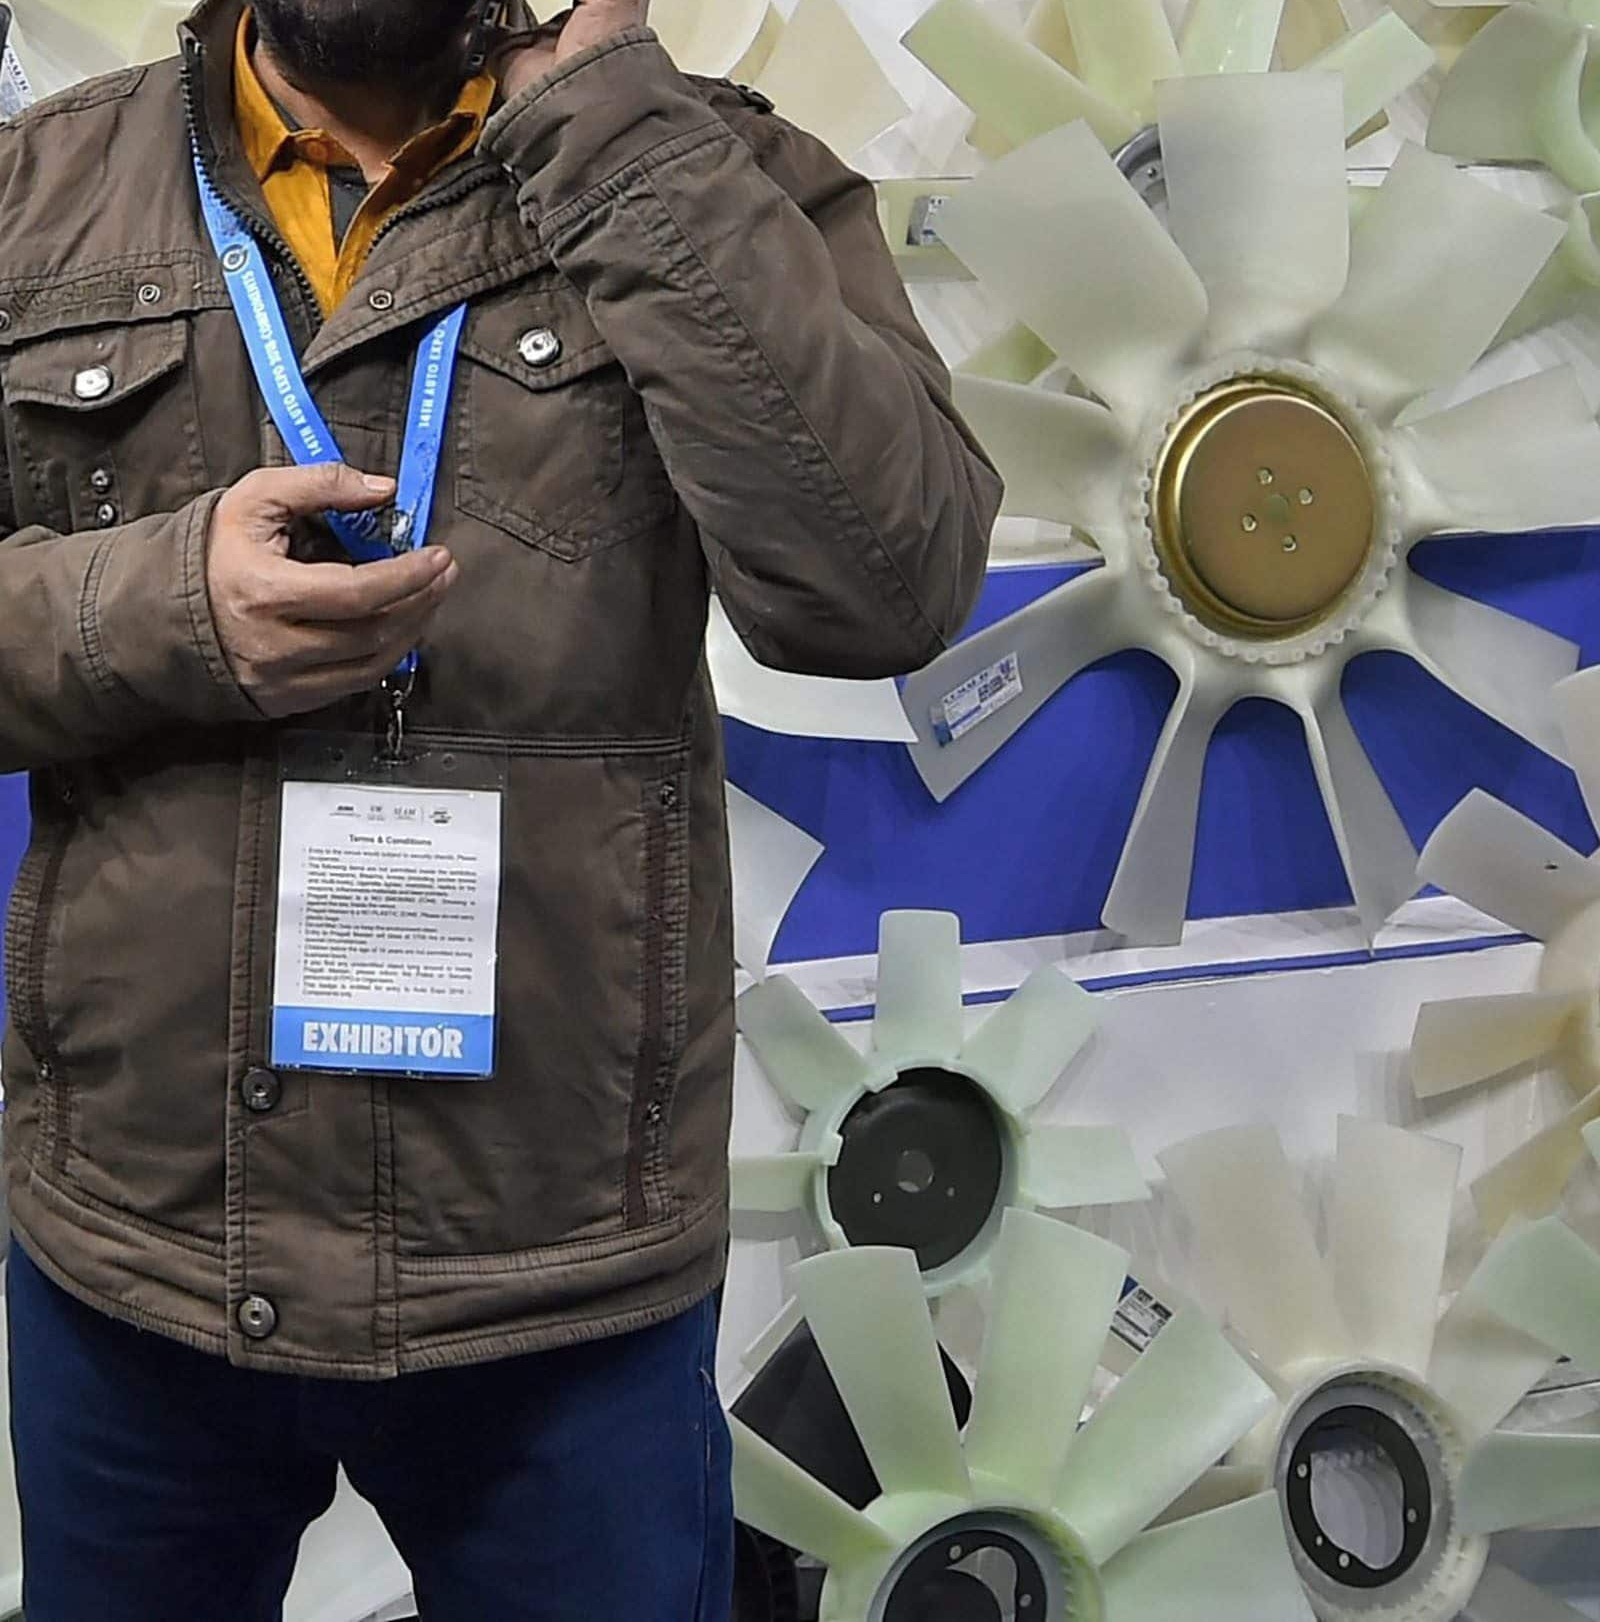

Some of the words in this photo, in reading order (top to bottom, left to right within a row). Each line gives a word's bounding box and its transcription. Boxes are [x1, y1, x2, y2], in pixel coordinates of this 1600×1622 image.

[429, 329, 445, 360] EXPO
[424, 363, 439, 396] AUTO
[418, 399, 434, 427] 14TH
[348, 834, 374, 843] Terms
[385, 836, 432, 846] Conditions
[303, 1021, 463, 1059] EXHIBITOR
